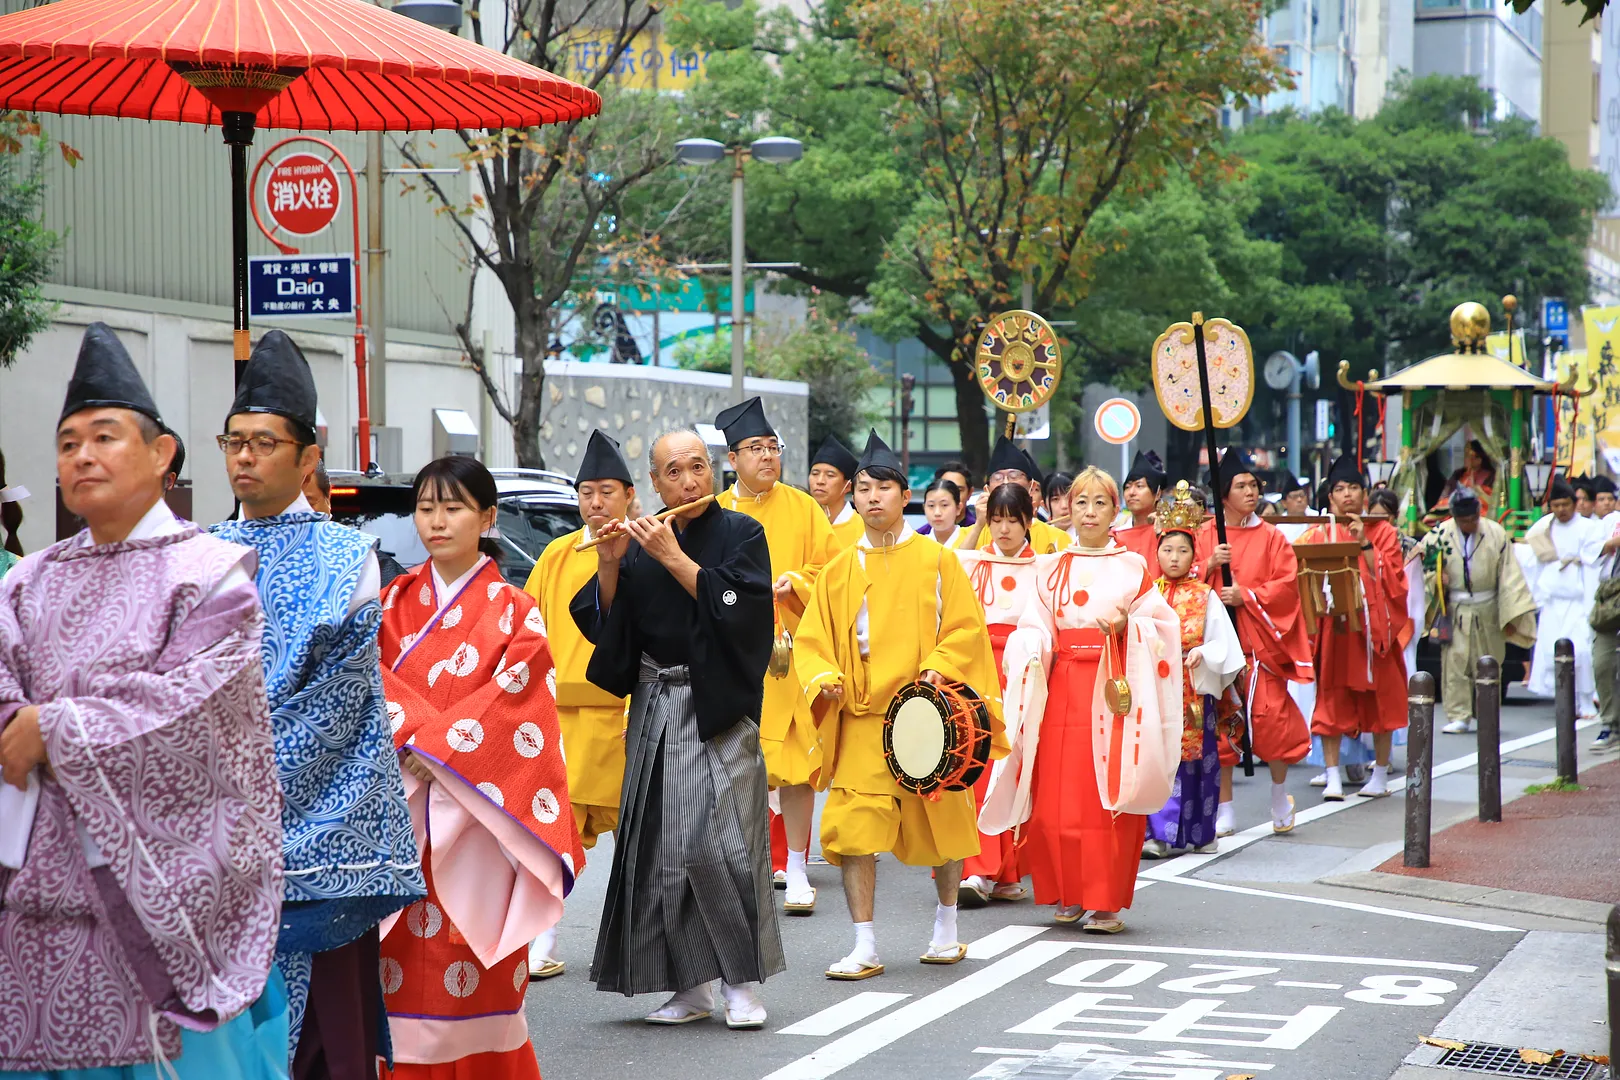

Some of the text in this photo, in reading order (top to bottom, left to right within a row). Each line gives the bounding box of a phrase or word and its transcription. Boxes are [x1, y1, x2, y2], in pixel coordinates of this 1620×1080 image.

[574, 41, 712, 79] 近鉄の仲
[277, 163, 325, 177] FIRE HYDRANT
[271, 177, 334, 213] 消火栓
[276, 277, 325, 296] Daio
